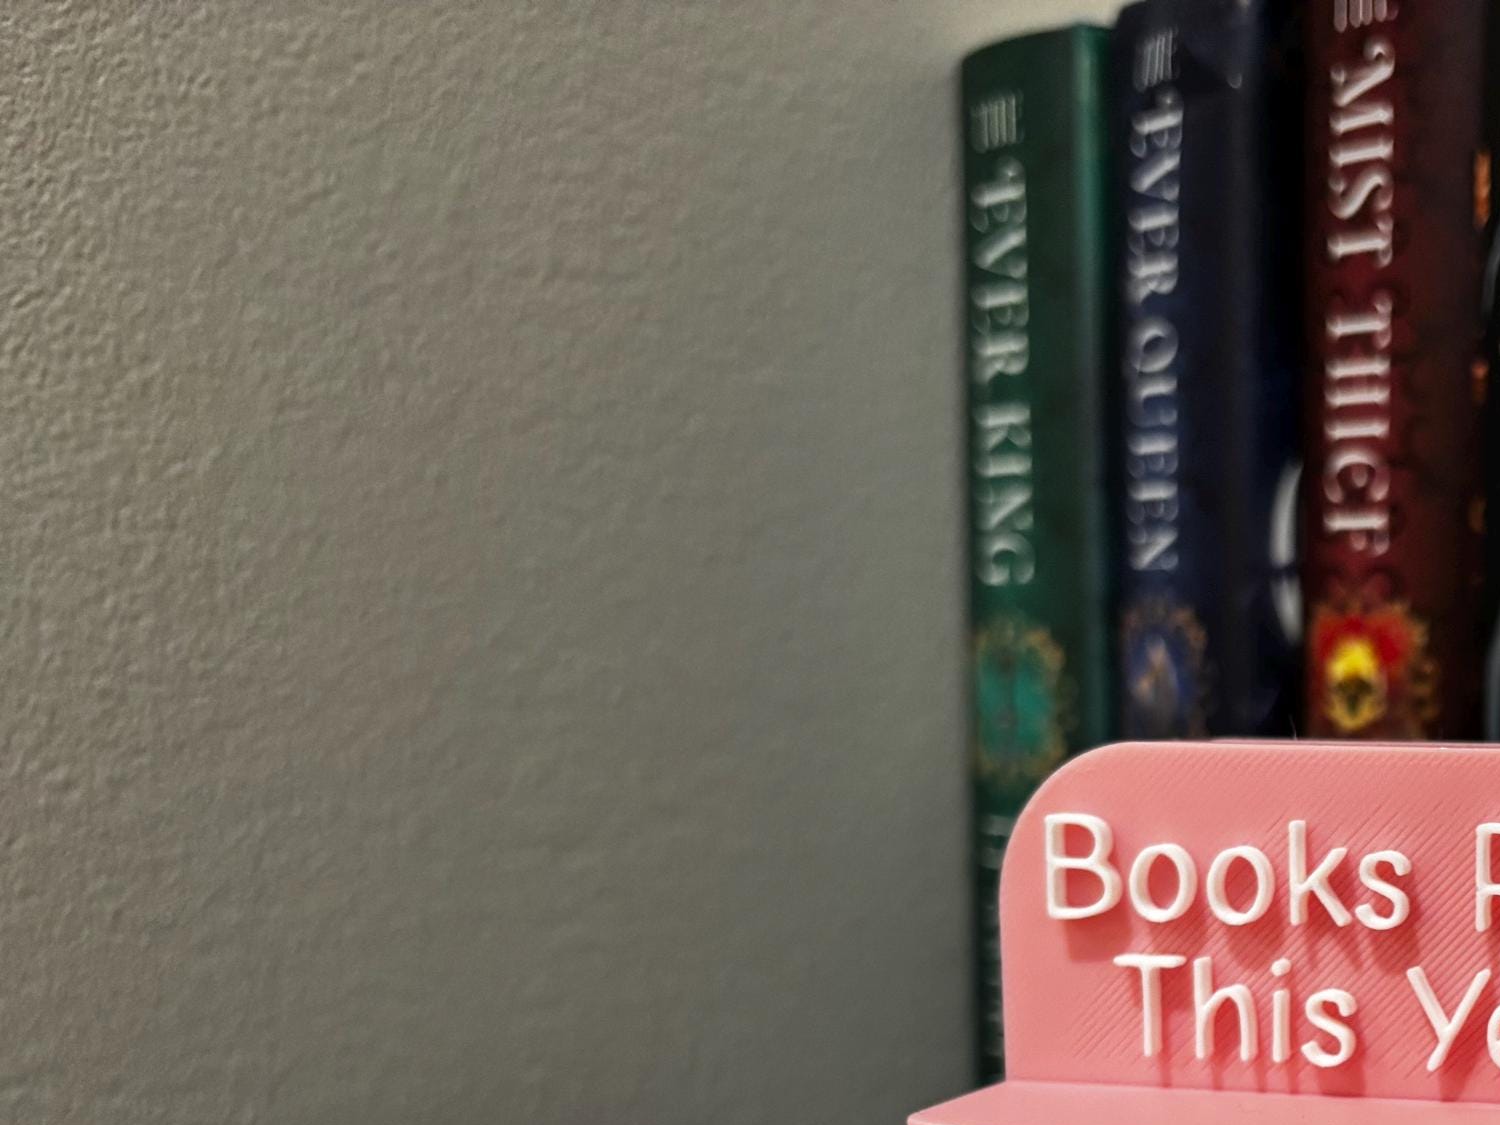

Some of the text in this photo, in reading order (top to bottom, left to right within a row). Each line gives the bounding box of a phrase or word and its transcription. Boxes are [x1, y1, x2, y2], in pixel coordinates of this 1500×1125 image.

[1127, 89, 1184, 303] EVER
[1327, 38, 1395, 268] MIST
[970, 156, 1030, 382] EVER
[973, 400, 1035, 587] KING
[1127, 316, 1180, 572] QUEEN
[1043, 812, 1412, 931] Books
[1113, 953, 1358, 1068] This
